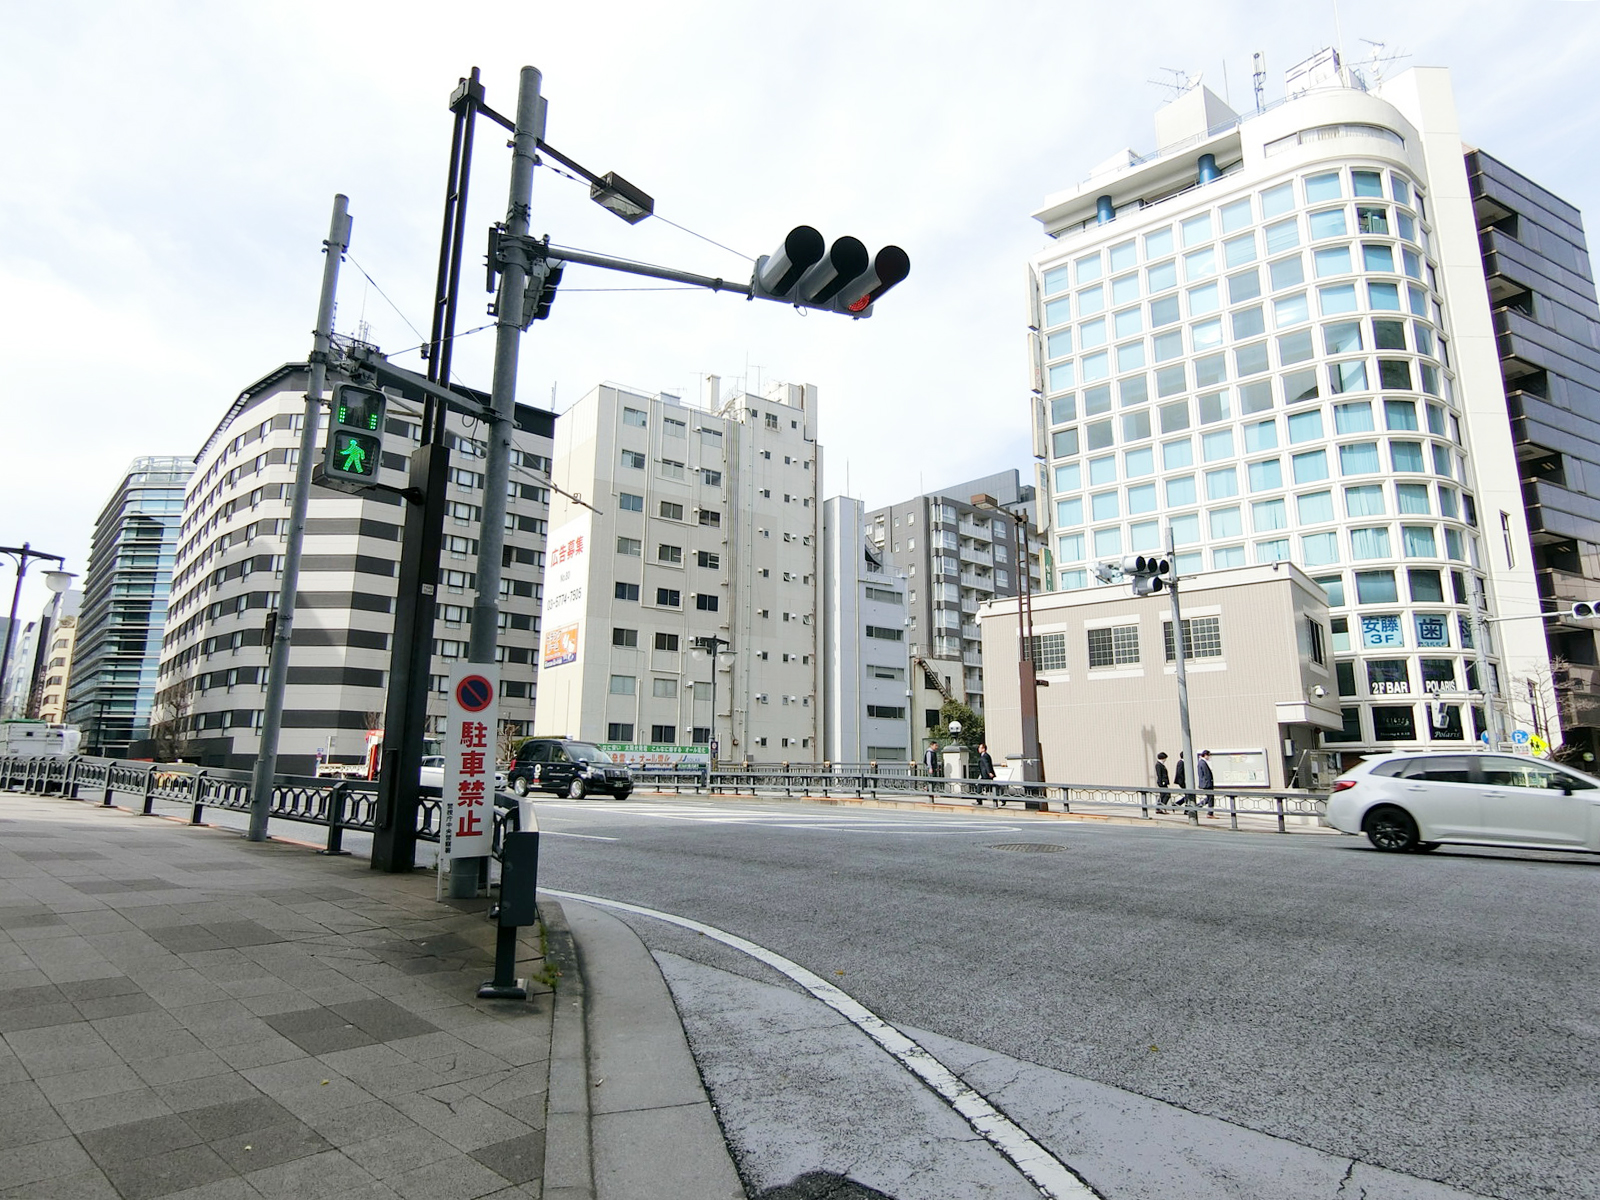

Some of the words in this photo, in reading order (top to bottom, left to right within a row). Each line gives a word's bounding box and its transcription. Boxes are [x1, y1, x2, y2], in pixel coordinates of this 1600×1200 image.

[550, 536, 584, 568] 広告募集
[1363, 616, 1399, 634] 安藤
[1419, 618, 1444, 640] 歯
[1370, 634, 1394, 644] 3F
[1386, 681, 1409, 694] BAR
[1425, 680, 1456, 693] POLARIS
[1434, 728, 1460, 738] Polaris
[455, 721, 488, 838] 駐車禁止
